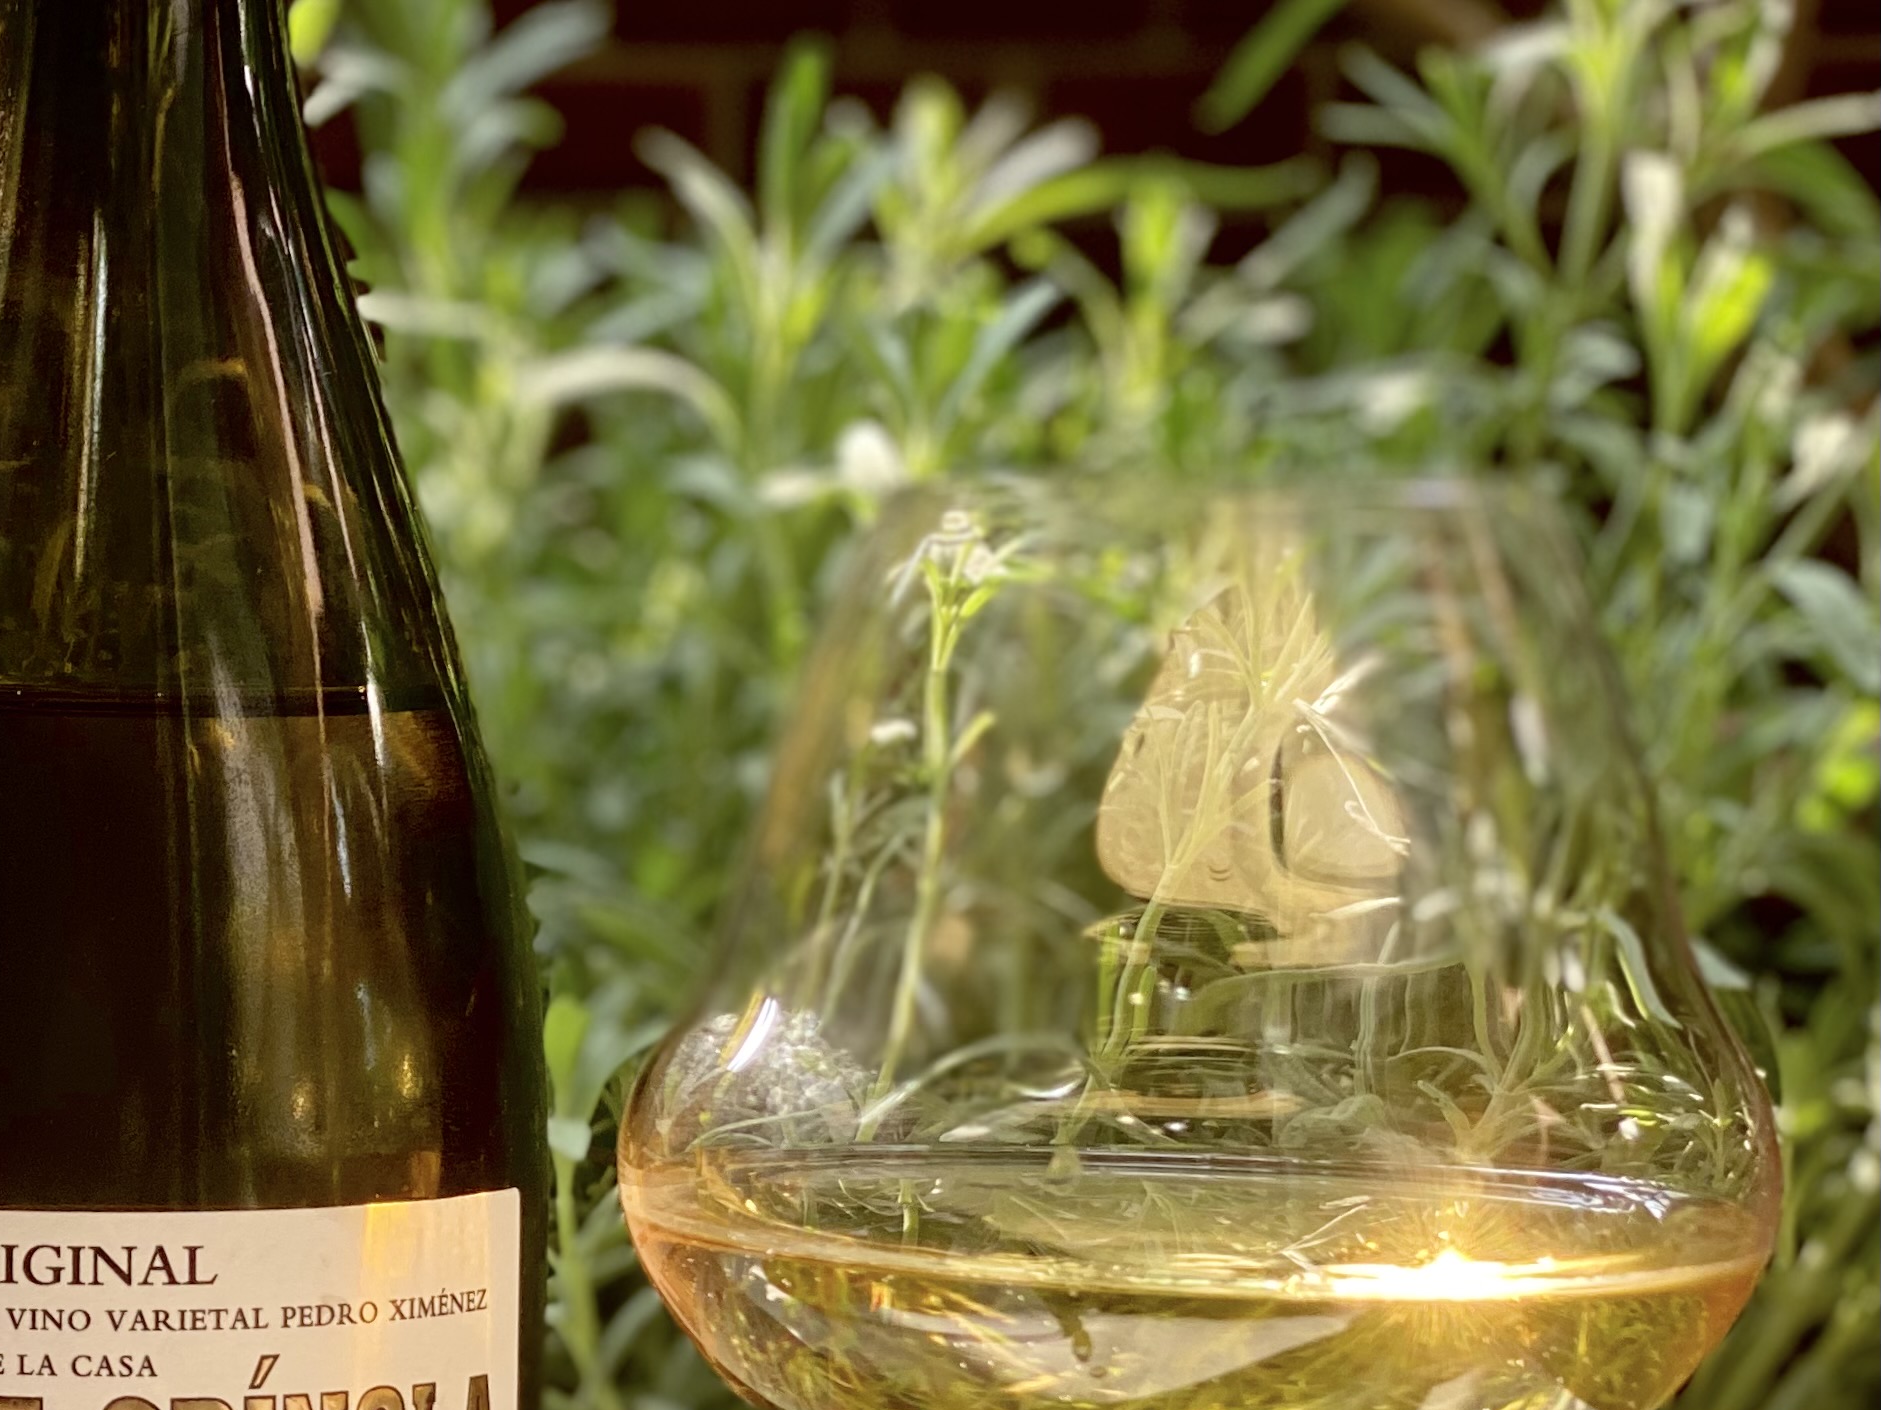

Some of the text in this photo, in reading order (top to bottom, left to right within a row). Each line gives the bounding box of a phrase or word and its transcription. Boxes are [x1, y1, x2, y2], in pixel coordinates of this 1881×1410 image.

[6, 1308, 91, 1332] VINO
[107, 1307, 269, 1331] VARIETAL
[280, 1301, 379, 1328] PEDRO
[389, 1287, 488, 1321] XIMÉNEZ
[16, 1353, 57, 1377] LA
[71, 1354, 158, 1378] CASA
